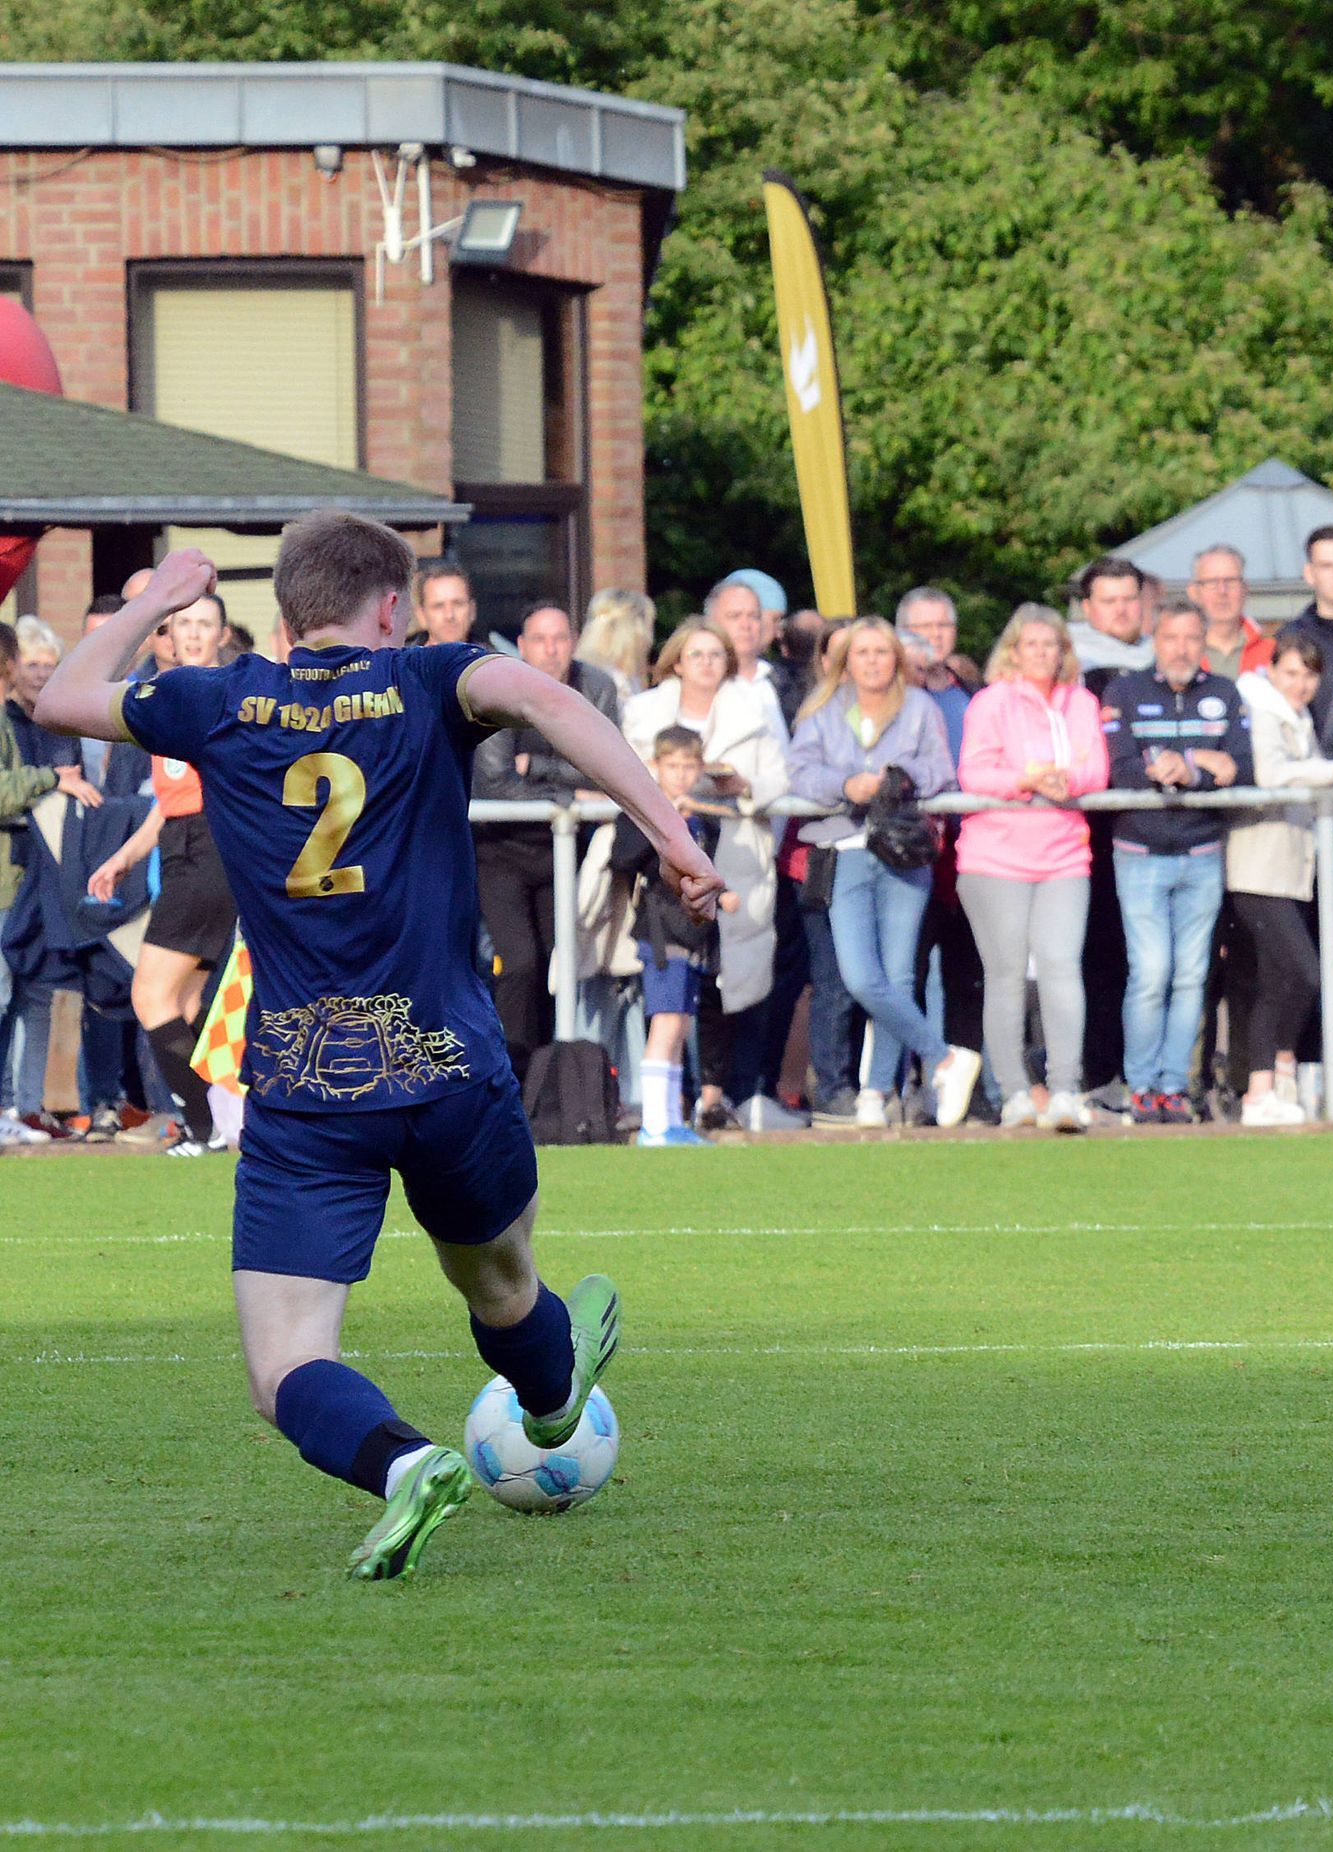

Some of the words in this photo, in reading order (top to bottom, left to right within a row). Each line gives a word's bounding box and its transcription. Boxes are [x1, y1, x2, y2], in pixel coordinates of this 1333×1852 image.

[237, 696, 277, 725] SV
[333, 686, 404, 723] GLEHN
[282, 752, 367, 898] 2
